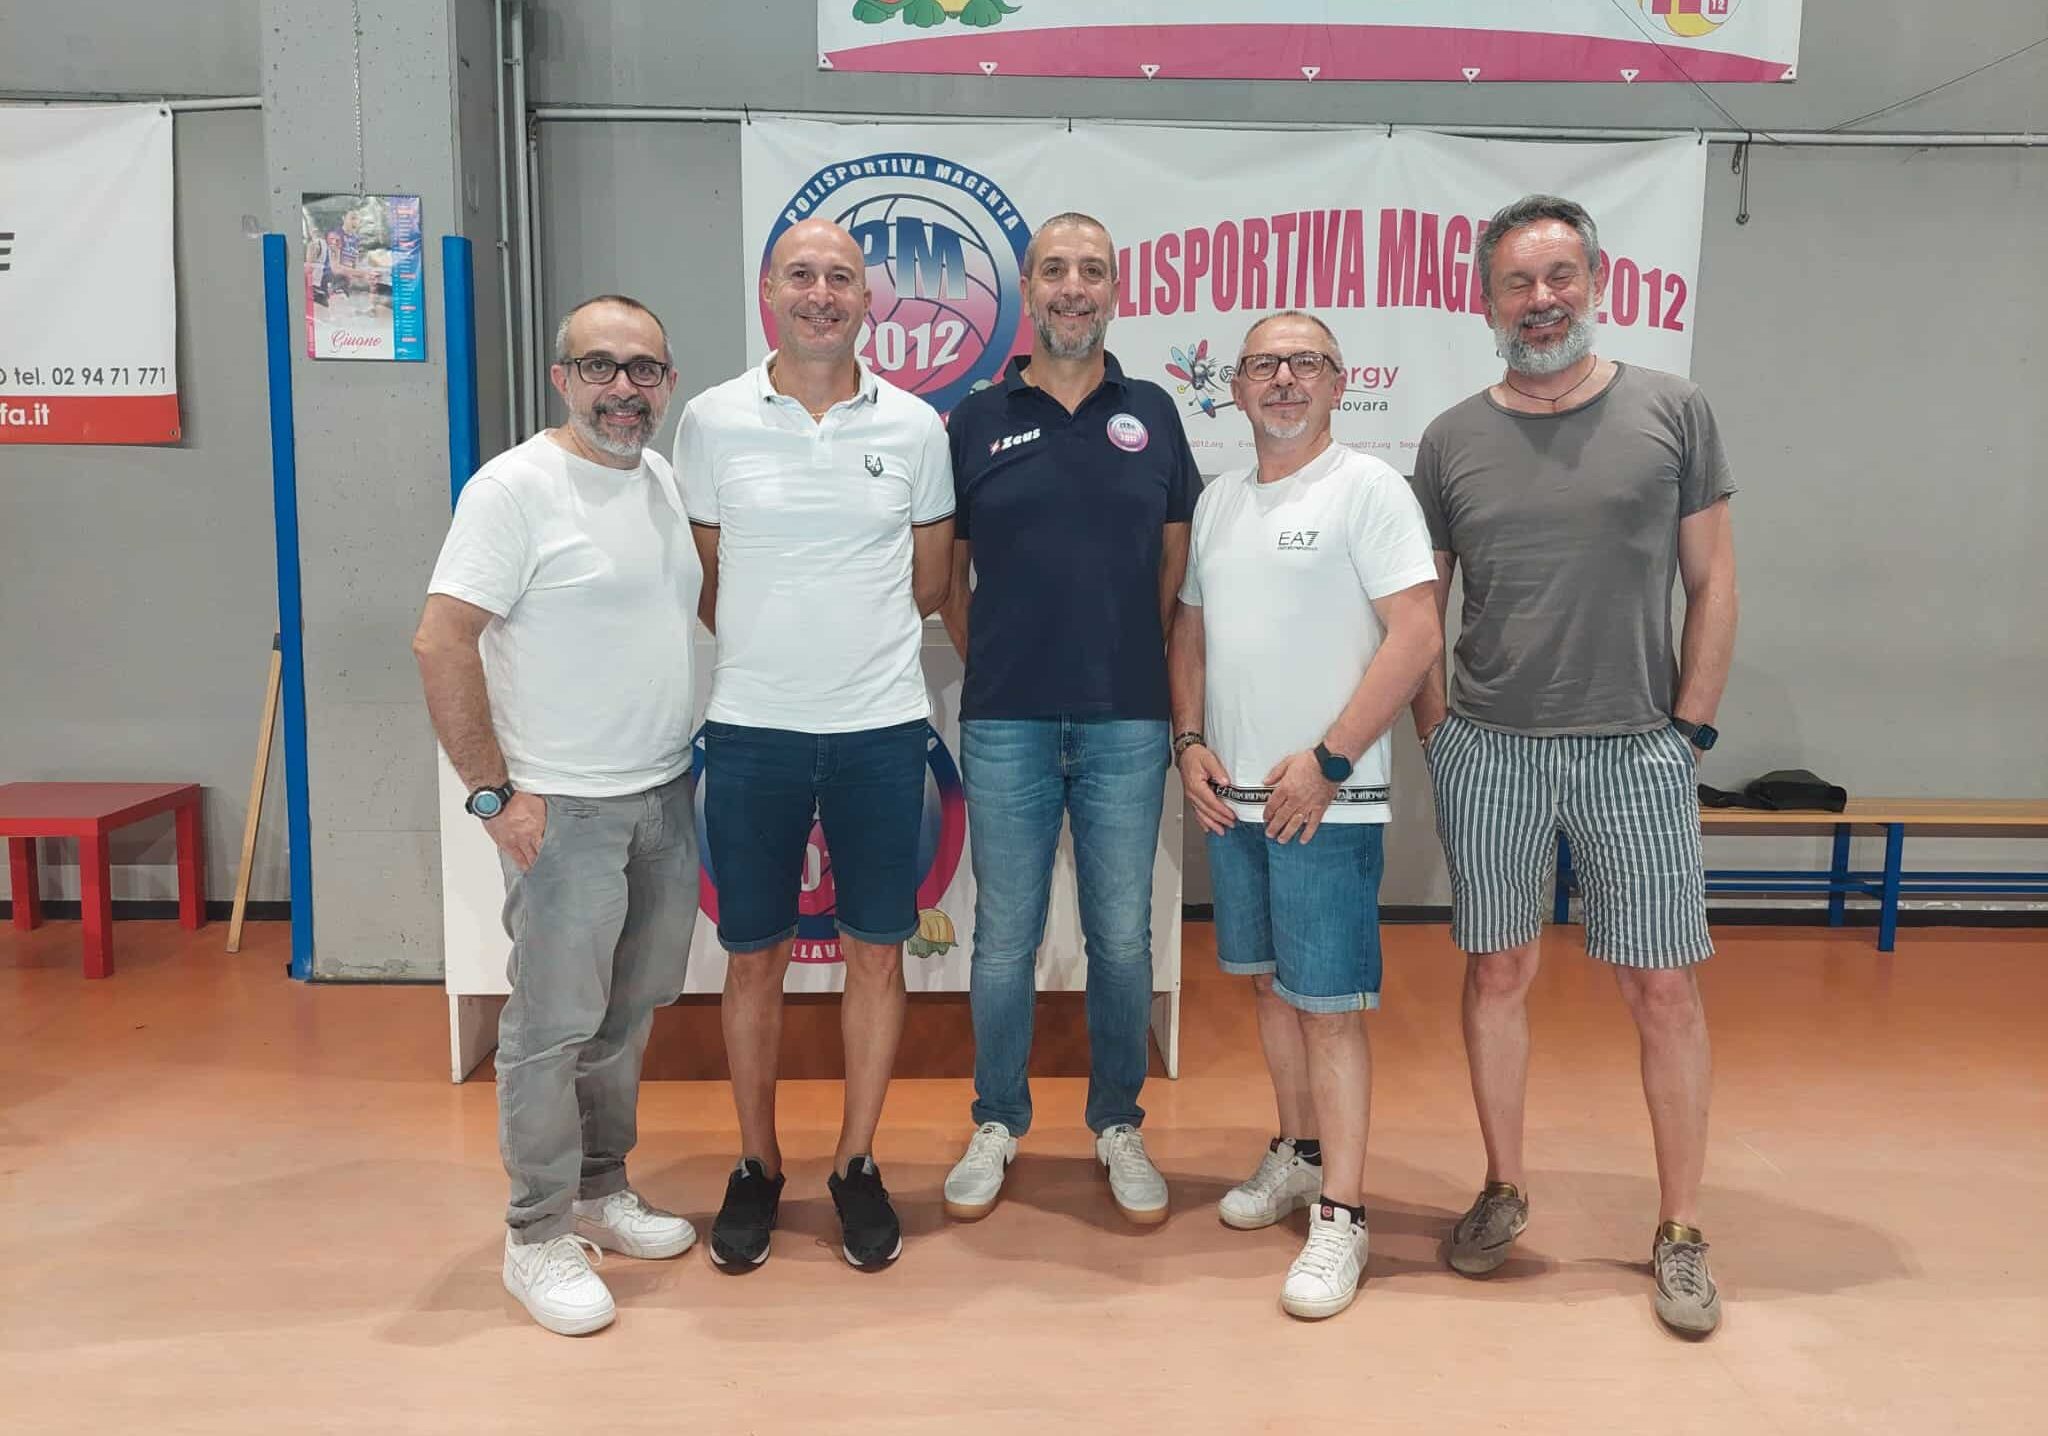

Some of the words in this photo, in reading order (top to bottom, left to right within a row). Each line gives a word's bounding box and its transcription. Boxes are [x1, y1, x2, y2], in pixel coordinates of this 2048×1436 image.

[785, 158, 926, 224] POLISPORTIVA
[935, 164, 1020, 231] MAGENTA
[1118, 208, 1368, 318] LISPORTIVA
[854, 320, 966, 371] 2012
[14, 367, 45, 386] tel.
[52, 367, 75, 385] 02
[82, 367, 104, 385] 94
[110, 367, 129, 385] 71
[138, 367, 166, 385] 771
[1344, 366, 1399, 389] rgy
[1279, 530, 1320, 546] EA7
